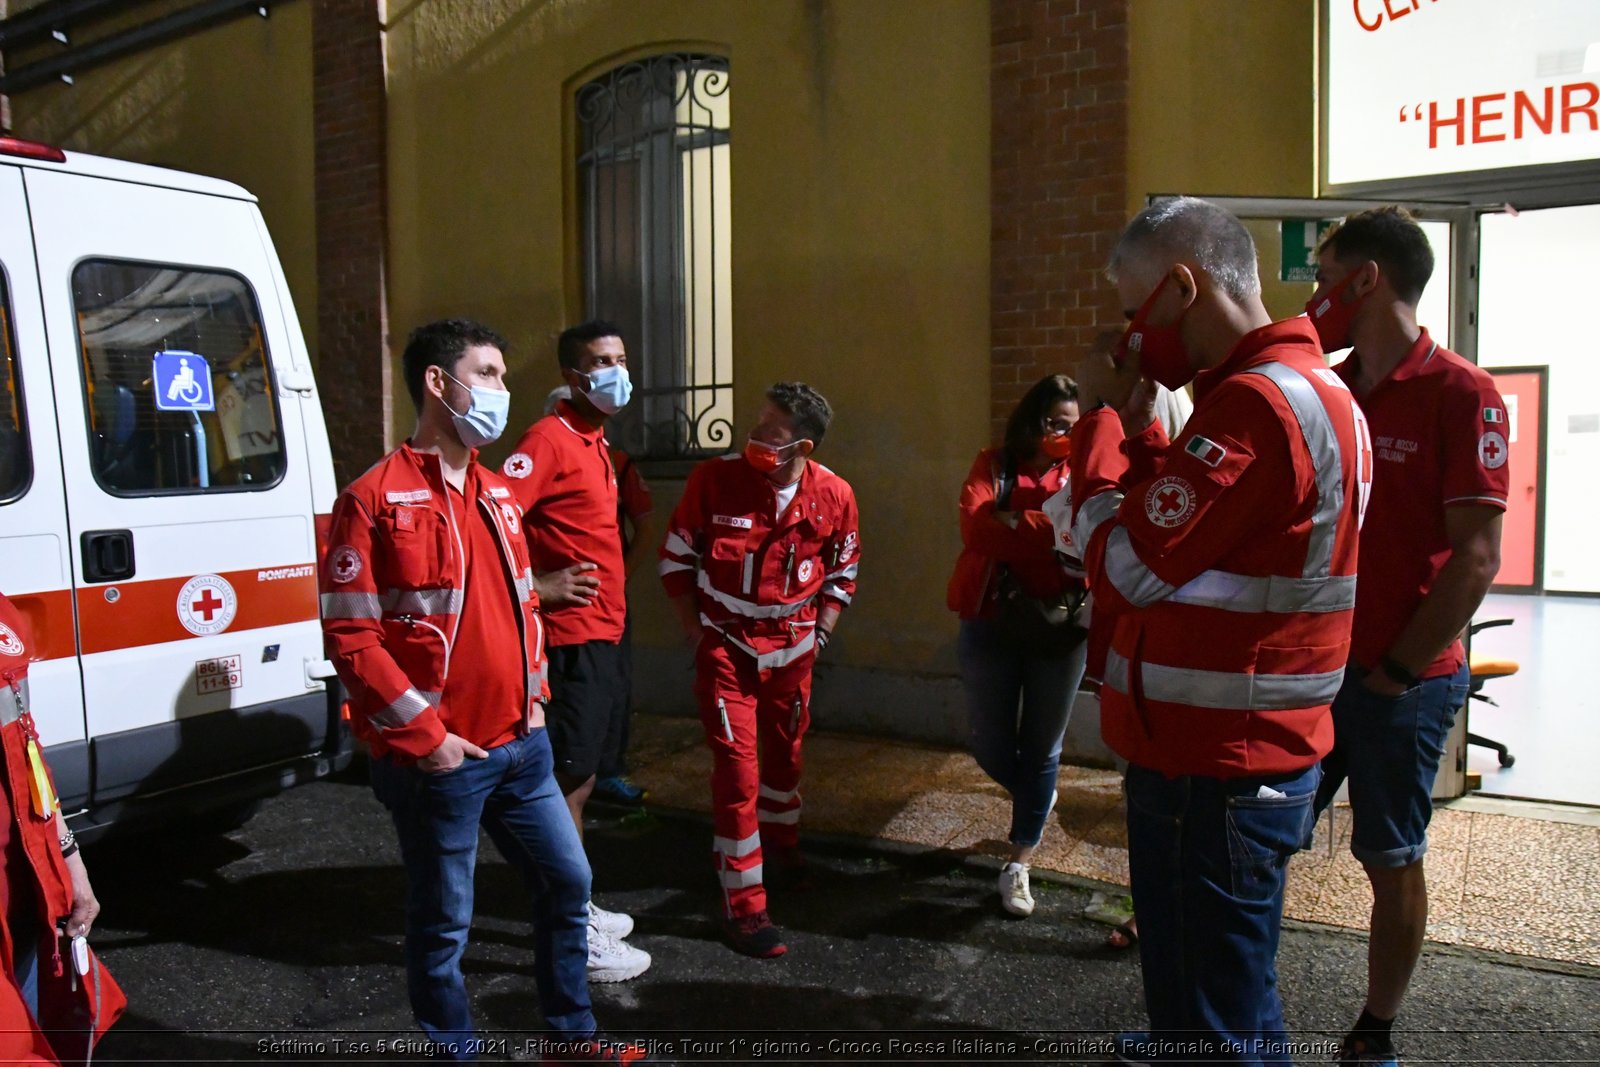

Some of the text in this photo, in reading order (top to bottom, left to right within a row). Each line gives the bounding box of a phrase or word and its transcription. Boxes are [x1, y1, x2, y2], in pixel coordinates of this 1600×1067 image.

[257, 566, 314, 582] BONFANTI
[199, 659, 236, 674] BG 24
